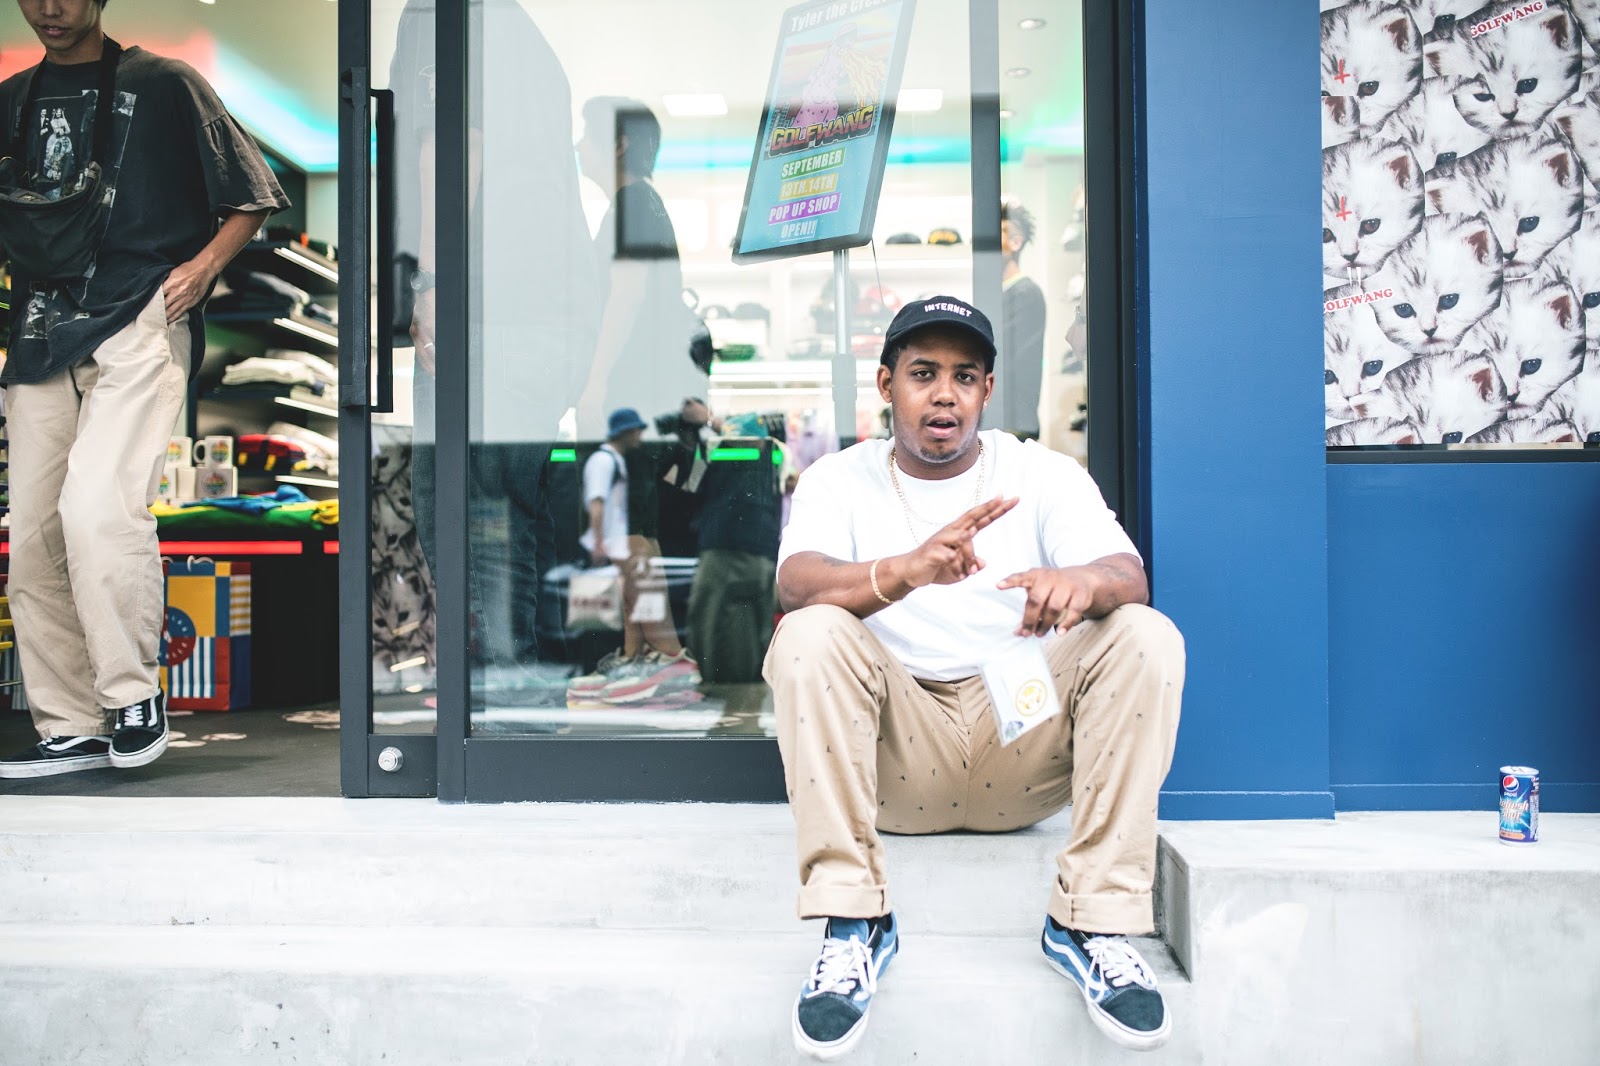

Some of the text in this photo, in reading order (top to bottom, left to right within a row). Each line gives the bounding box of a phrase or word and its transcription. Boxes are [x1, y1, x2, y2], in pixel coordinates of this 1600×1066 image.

[791, 10, 824, 32] Tyler
[825, 2, 848, 21] the
[770, 104, 875, 152] GOLFWANG
[781, 149, 843, 178] SEPTEMBER
[768, 194, 838, 222] POP UP SHOP
[924, 302, 973, 318] INTERNET
[1323, 288, 1393, 313] OLFWANG
